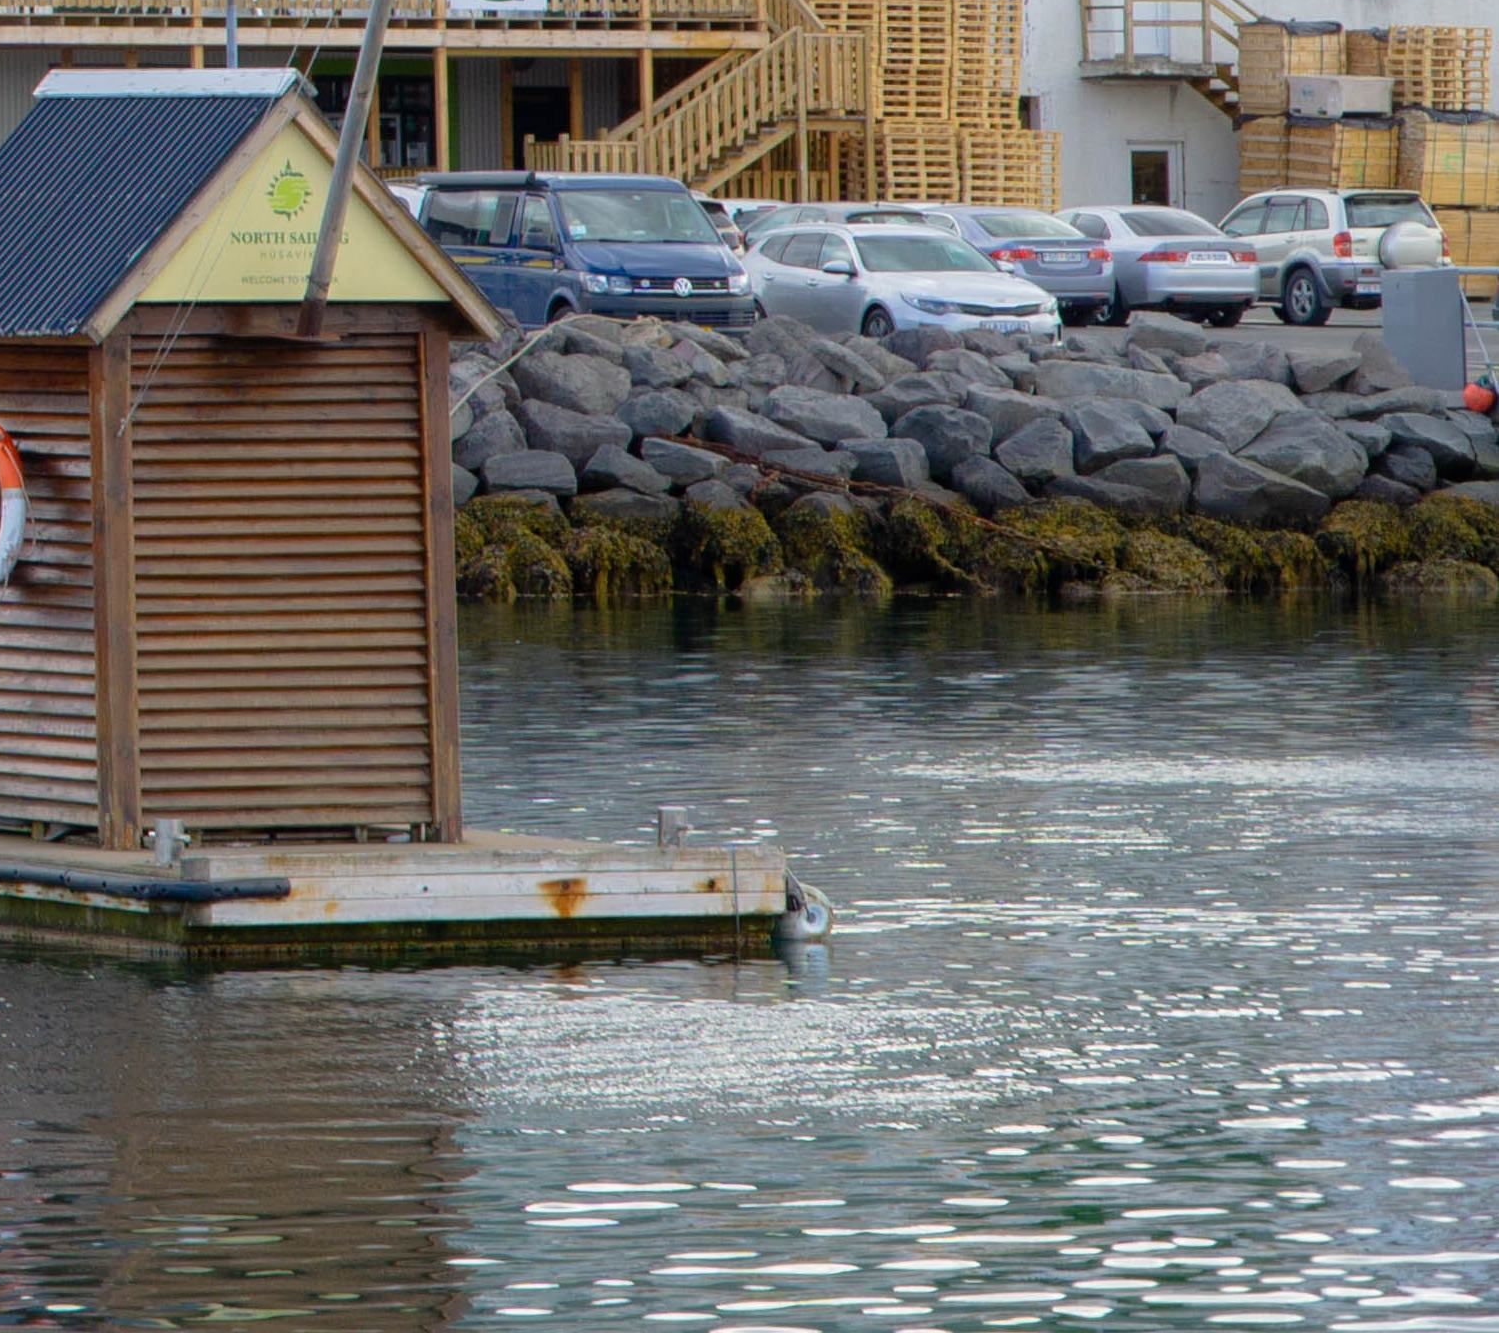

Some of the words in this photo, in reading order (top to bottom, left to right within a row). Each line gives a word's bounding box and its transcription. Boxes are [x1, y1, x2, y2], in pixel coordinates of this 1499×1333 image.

[231, 231, 286, 245] NORTH
[289, 231, 349, 245] SAILG
[241, 275, 287, 285] WELCOME
